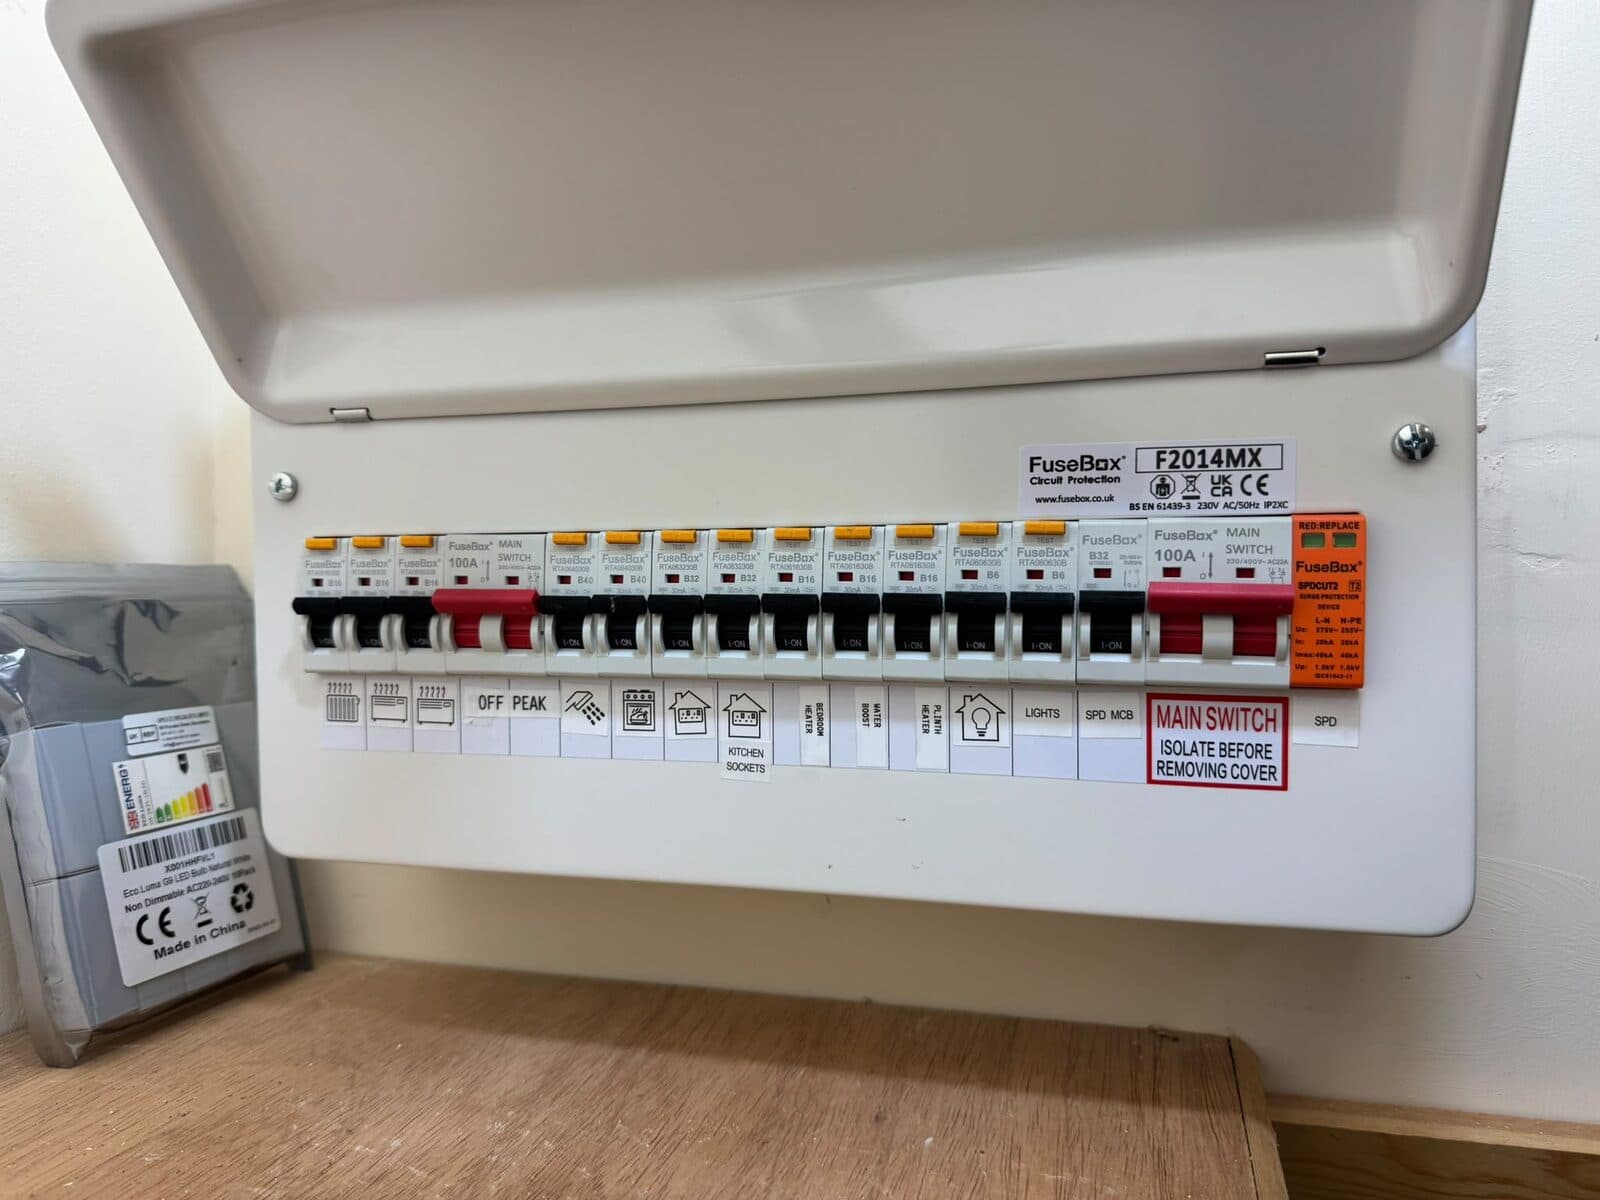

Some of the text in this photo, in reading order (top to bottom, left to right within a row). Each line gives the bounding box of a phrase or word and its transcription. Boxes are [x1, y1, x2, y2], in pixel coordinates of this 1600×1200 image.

[1155, 447, 1262, 470] F2014MX
[1029, 474, 1121, 486] Circuit Protection
[1210, 474, 1232, 486] UK
[1210, 486, 1233, 497] CA
[1035, 494, 1115, 504] www.fusebox.co.uk
[1129, 500, 1289, 511] BS EN 61439-3 230V AC/50Hz IP2XC
[1299, 521, 1360, 530] RED:REPLACE
[1226, 527, 1260, 538] MAIN
[498, 540, 523, 549] MAIN
[1225, 544, 1273, 555] SWITCH
[498, 553, 532, 562] SWITCH
[1089, 551, 1109, 560] B32
[1155, 549, 1196, 562] 100A
[449, 557, 478, 568] 100A
[577, 576, 594, 584] B40
[630, 575, 647, 584] B40
[683, 575, 700, 583] B32
[740, 574, 757, 582] B32
[798, 576, 815, 584] B16
[859, 575, 877, 583] B16
[920, 574, 938, 582] B16
[986, 571, 1000, 579] B6
[1052, 571, 1065, 579] B6
[478, 694, 547, 711] OFF PEAK
[861, 703, 870, 728] BOOST
[873, 702, 882, 729] WATER
[1025, 706, 1060, 719] LIGHTS
[1085, 709, 1134, 720] SPD MCB
[804, 704, 813, 734] HEATER
[815, 702, 824, 737] BEDROOM
[921, 704, 930, 735] HEATER
[933, 704, 942, 735] PLINTH
[1156, 704, 1277, 733] MAIN SWITCH
[1314, 715, 1337, 728] SPD
[728, 746, 765, 758] KITCHEN
[1160, 738, 1273, 760] ISOLATE BEFORE
[726, 761, 765, 774] SOCKETS
[1156, 759, 1278, 782] REMOVING COVER
[175, 872, 190, 883] LED
[124, 902, 143, 913] Non
[144, 889, 185, 908] Dimmable
[153, 939, 191, 960] Made
[193, 933, 208, 945] in
[209, 920, 247, 939] China
